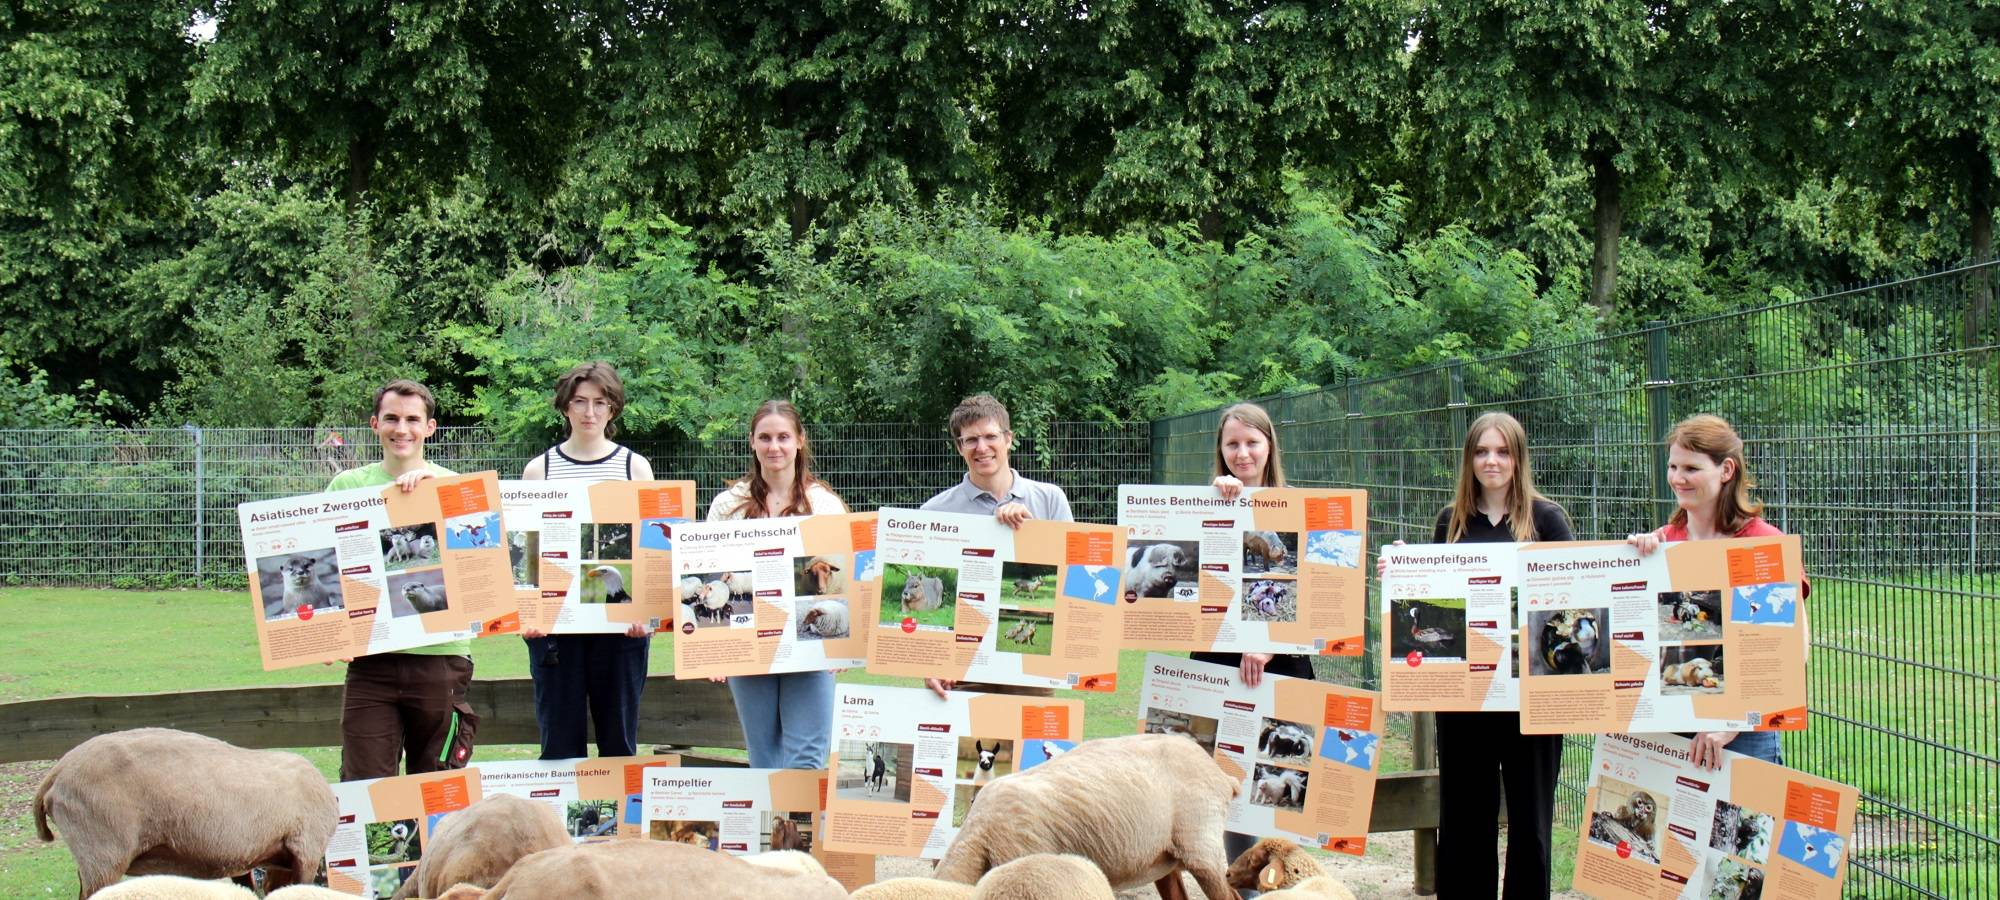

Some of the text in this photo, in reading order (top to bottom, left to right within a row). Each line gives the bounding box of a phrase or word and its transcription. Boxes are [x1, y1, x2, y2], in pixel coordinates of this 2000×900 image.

[1126, 495, 1288, 508] Buntes Bentheimer Schwein
[250, 497, 389, 523] Asiatischer Zwergotter
[887, 518, 959, 533] Großer Mara
[680, 527, 797, 542] Coburger Fuchsschaf
[1391, 554, 1488, 566] Witwenpfeifgans
[1527, 557, 1641, 573] Meerschweinchen
[1153, 664, 1231, 687] Streifenskunk
[843, 695, 874, 706] Lama
[551, 768, 611, 778] Baumstachler
[652, 777, 712, 789] Trampeltier
